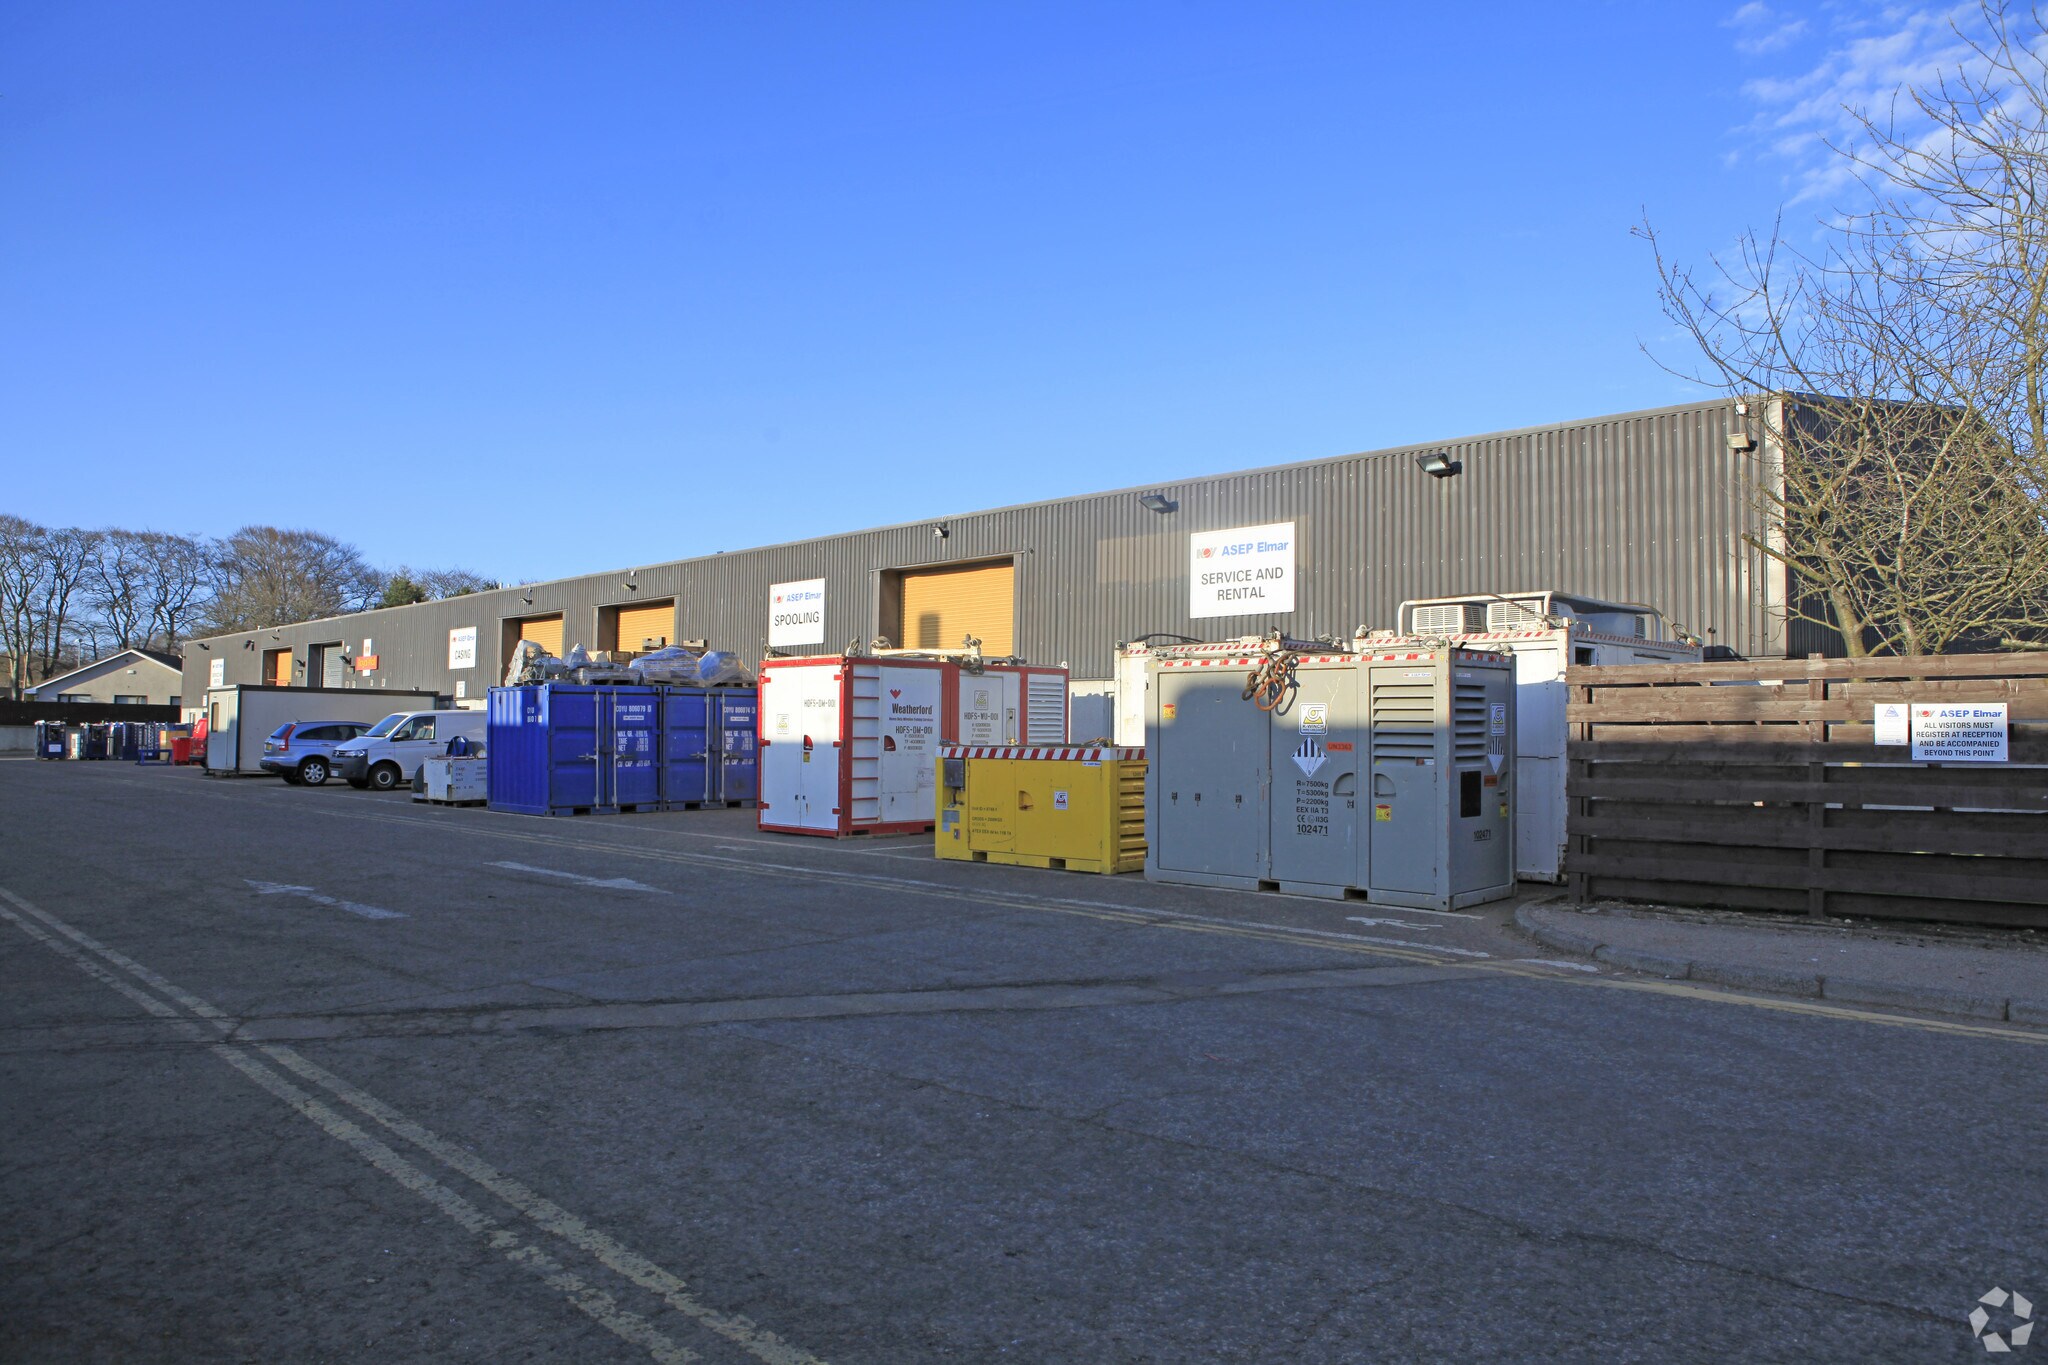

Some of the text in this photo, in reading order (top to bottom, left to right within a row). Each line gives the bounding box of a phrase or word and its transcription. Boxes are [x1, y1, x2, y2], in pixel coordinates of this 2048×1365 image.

[1222, 543, 1253, 557] ASEP
[1257, 542, 1288, 553] Elmar
[1201, 567, 1284, 585] SERVICE AND
[786, 593, 803, 602] ASEP
[805, 592, 822, 600] Elmar
[1217, 586, 1265, 601] RENTAL
[774, 611, 820, 627] SPOOLING
[892, 703, 933, 715] Weatherford
[1296, 780, 1328, 789] R=7500kg
[1296, 789, 1328, 798] T=5300kg
[1296, 798, 1328, 807] P=2200kg
[1297, 815, 1305, 823] CE
[1297, 824, 1328, 834] 102471
[1473, 829, 1491, 840] 102471
